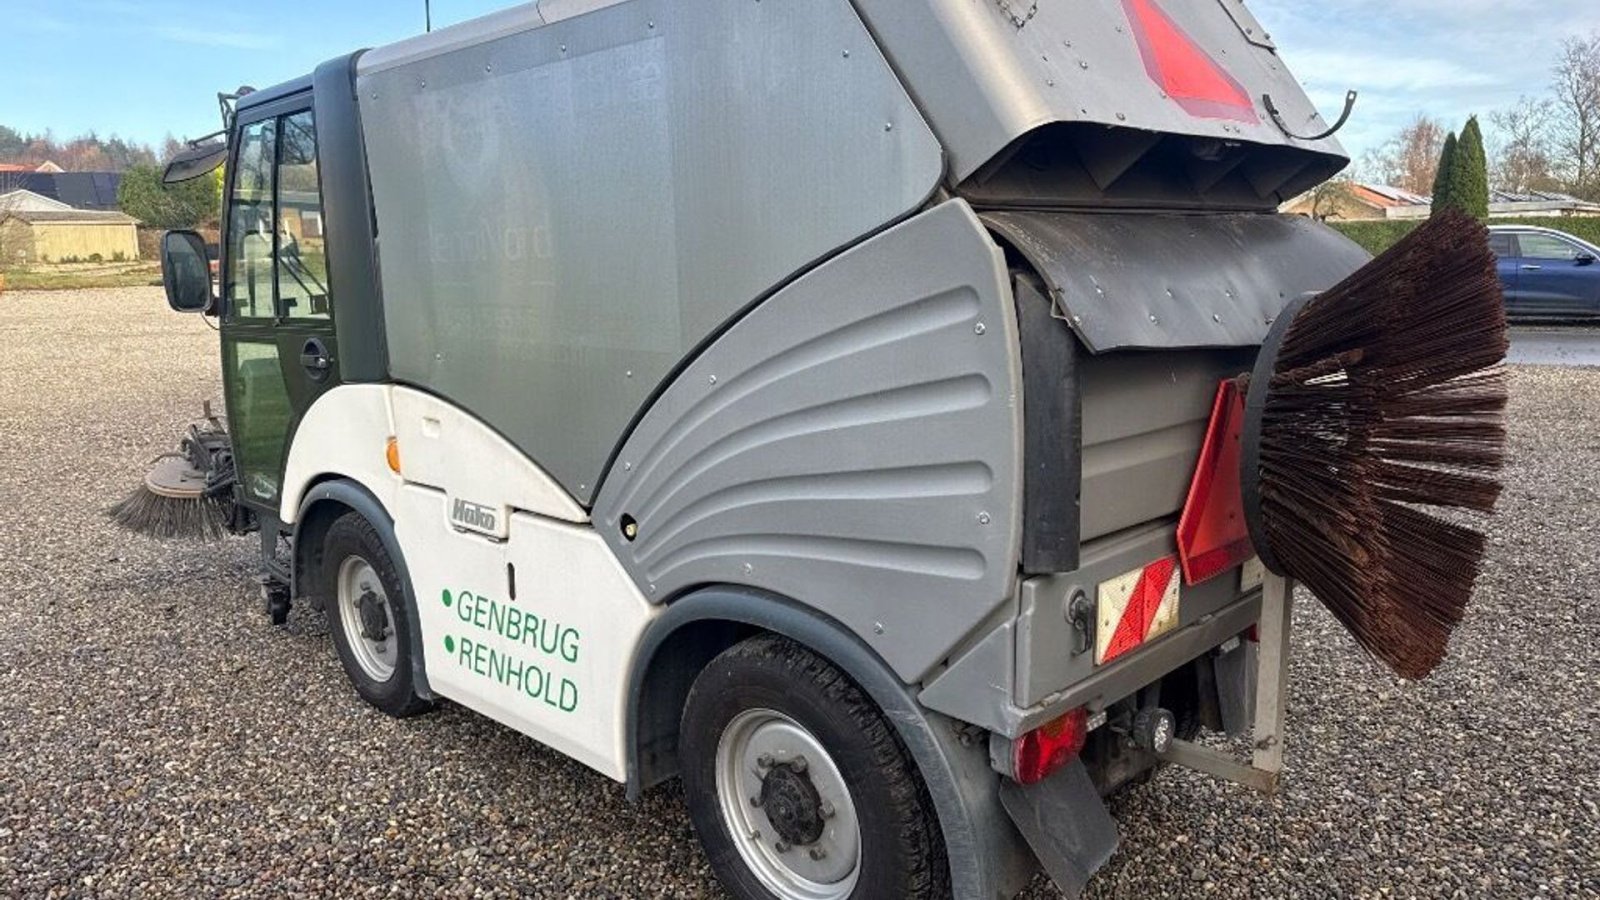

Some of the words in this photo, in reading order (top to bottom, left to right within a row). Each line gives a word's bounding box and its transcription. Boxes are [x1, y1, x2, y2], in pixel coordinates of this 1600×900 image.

[453, 498, 496, 530] Hako
[457, 591, 580, 663] GENBRUG
[459, 637, 578, 712] RENHOLD
